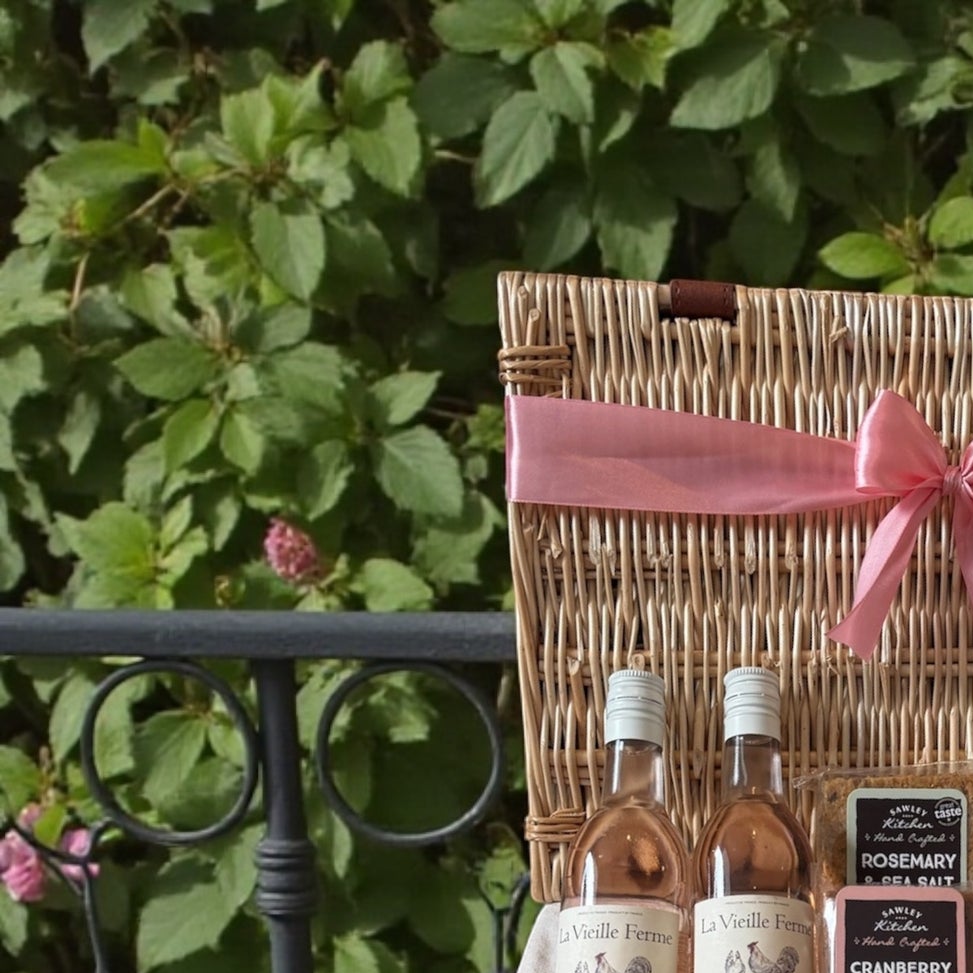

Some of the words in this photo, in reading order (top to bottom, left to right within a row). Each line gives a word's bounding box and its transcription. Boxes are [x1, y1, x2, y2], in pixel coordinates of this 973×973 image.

[889, 804, 928, 817] SAWLEY
[934, 808, 962, 819] taste
[882, 818, 934, 830] Kitchen
[873, 832, 904, 843] Hand
[908, 832, 946, 848] Crafted
[861, 853, 957, 869] ROSEMARY
[881, 905, 923, 919] SAWLEY
[701, 918, 716, 934] La
[720, 912, 770, 929] Vieille
[775, 914, 812, 937] Ferme
[874, 919, 929, 932] Kitchen
[560, 928, 570, 944] La
[573, 922, 620, 940] Vieille
[625, 923, 673, 945] Ferme
[862, 936, 895, 946] Hand
[899, 936, 941, 953] Crafted
